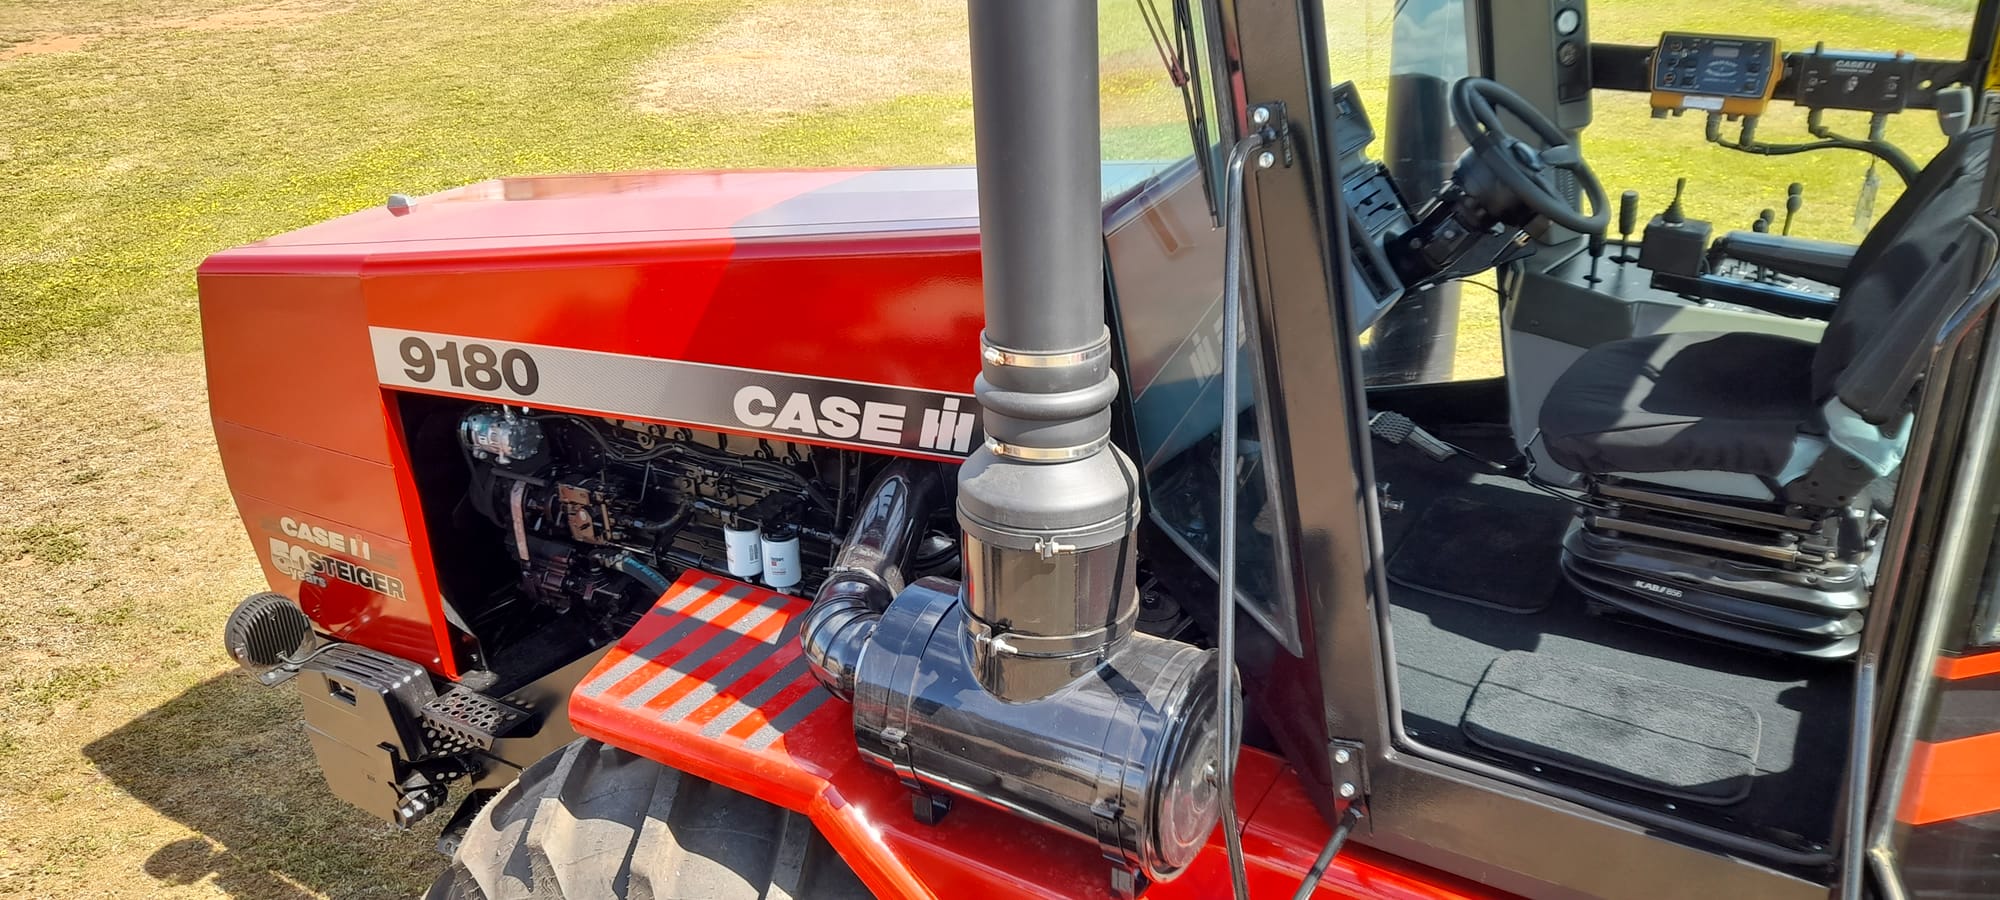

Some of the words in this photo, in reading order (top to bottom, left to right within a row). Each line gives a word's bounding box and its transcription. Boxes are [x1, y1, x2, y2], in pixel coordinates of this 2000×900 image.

[1835, 60, 1866, 69] CASE
[399, 336, 540, 396] 9180
[733, 385, 907, 445] CASE
[280, 517, 346, 553] CASE
[269, 537, 314, 576] 50
[306, 551, 407, 602] STEIGER
[289, 567, 327, 589] years
